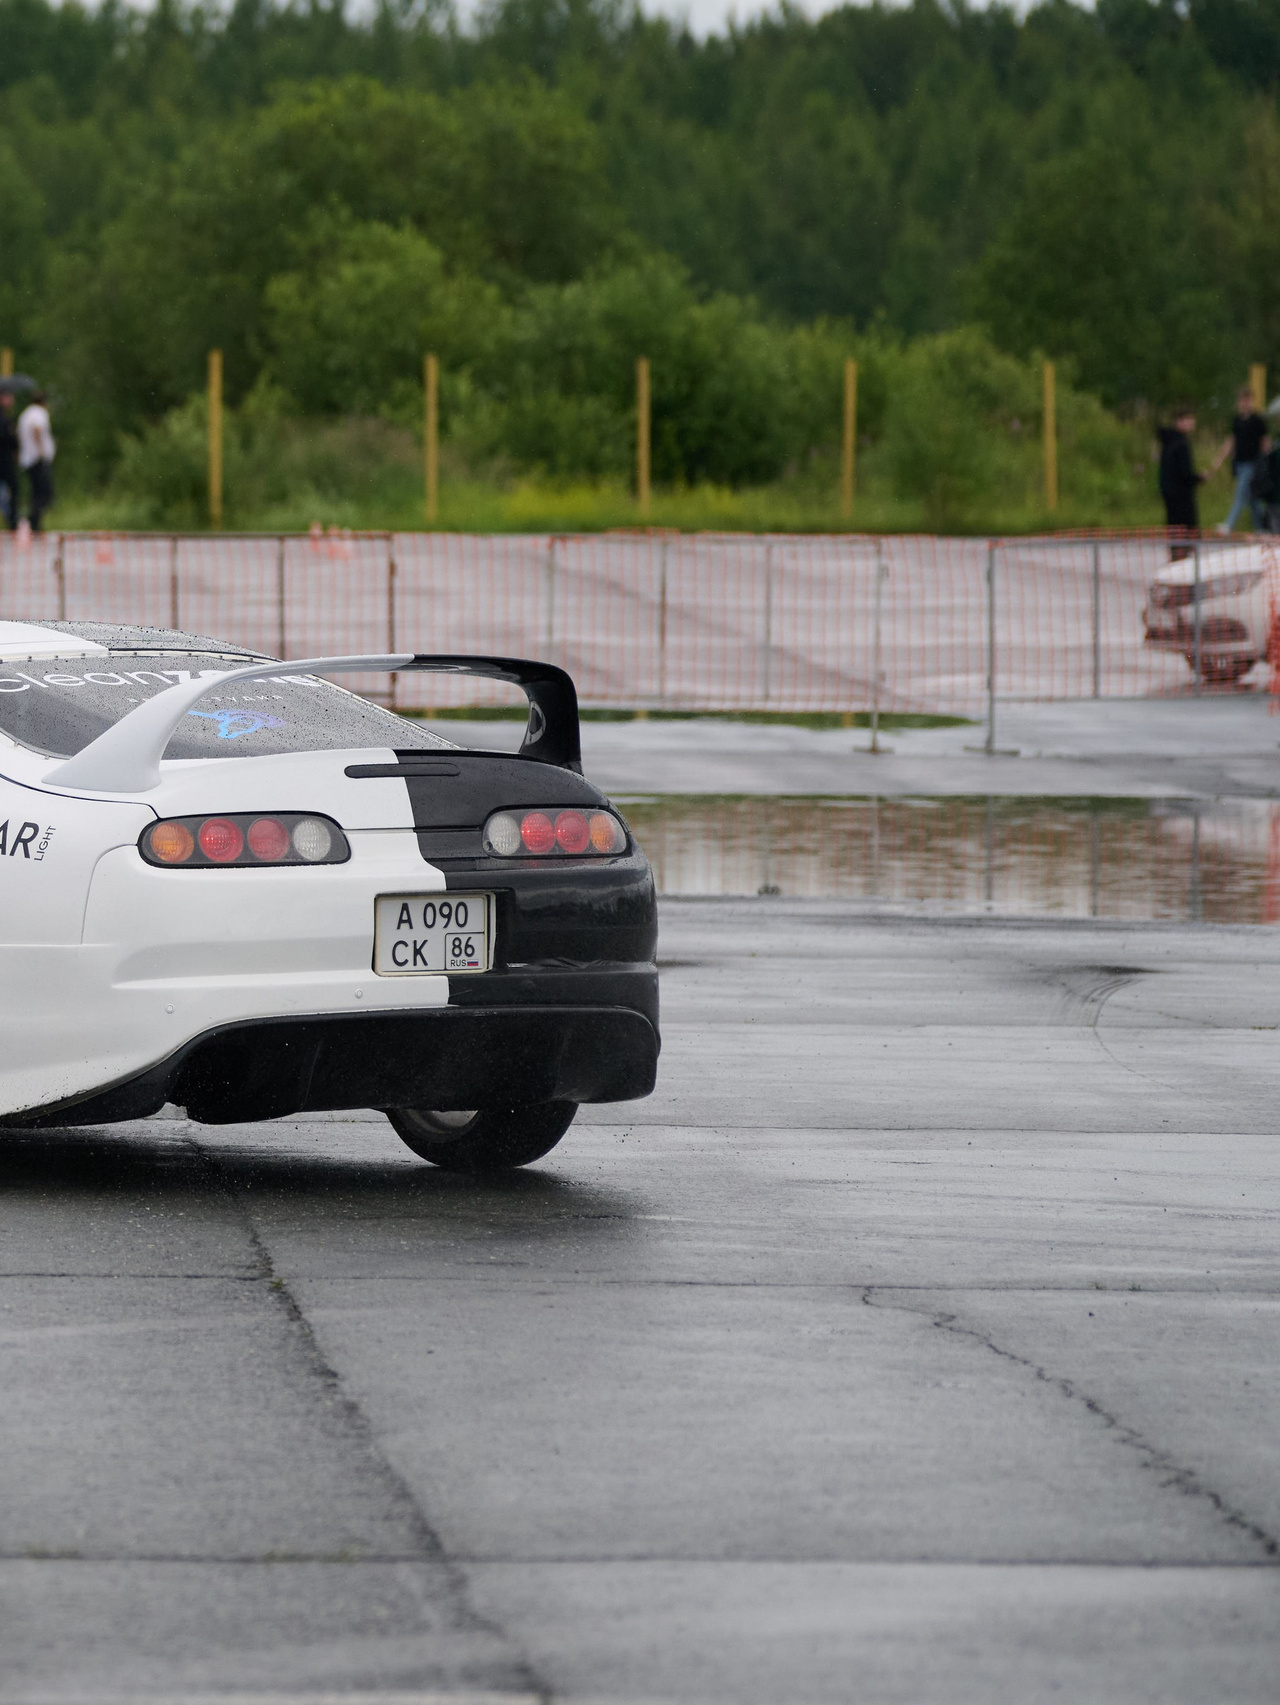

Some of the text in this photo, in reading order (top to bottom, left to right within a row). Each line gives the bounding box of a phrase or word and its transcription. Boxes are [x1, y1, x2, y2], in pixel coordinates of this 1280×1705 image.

[33, 825, 57, 862] LIGHT
[423, 901, 469, 929] 090
[451, 936, 476, 958] 86
[450, 959, 467, 967] RUS
